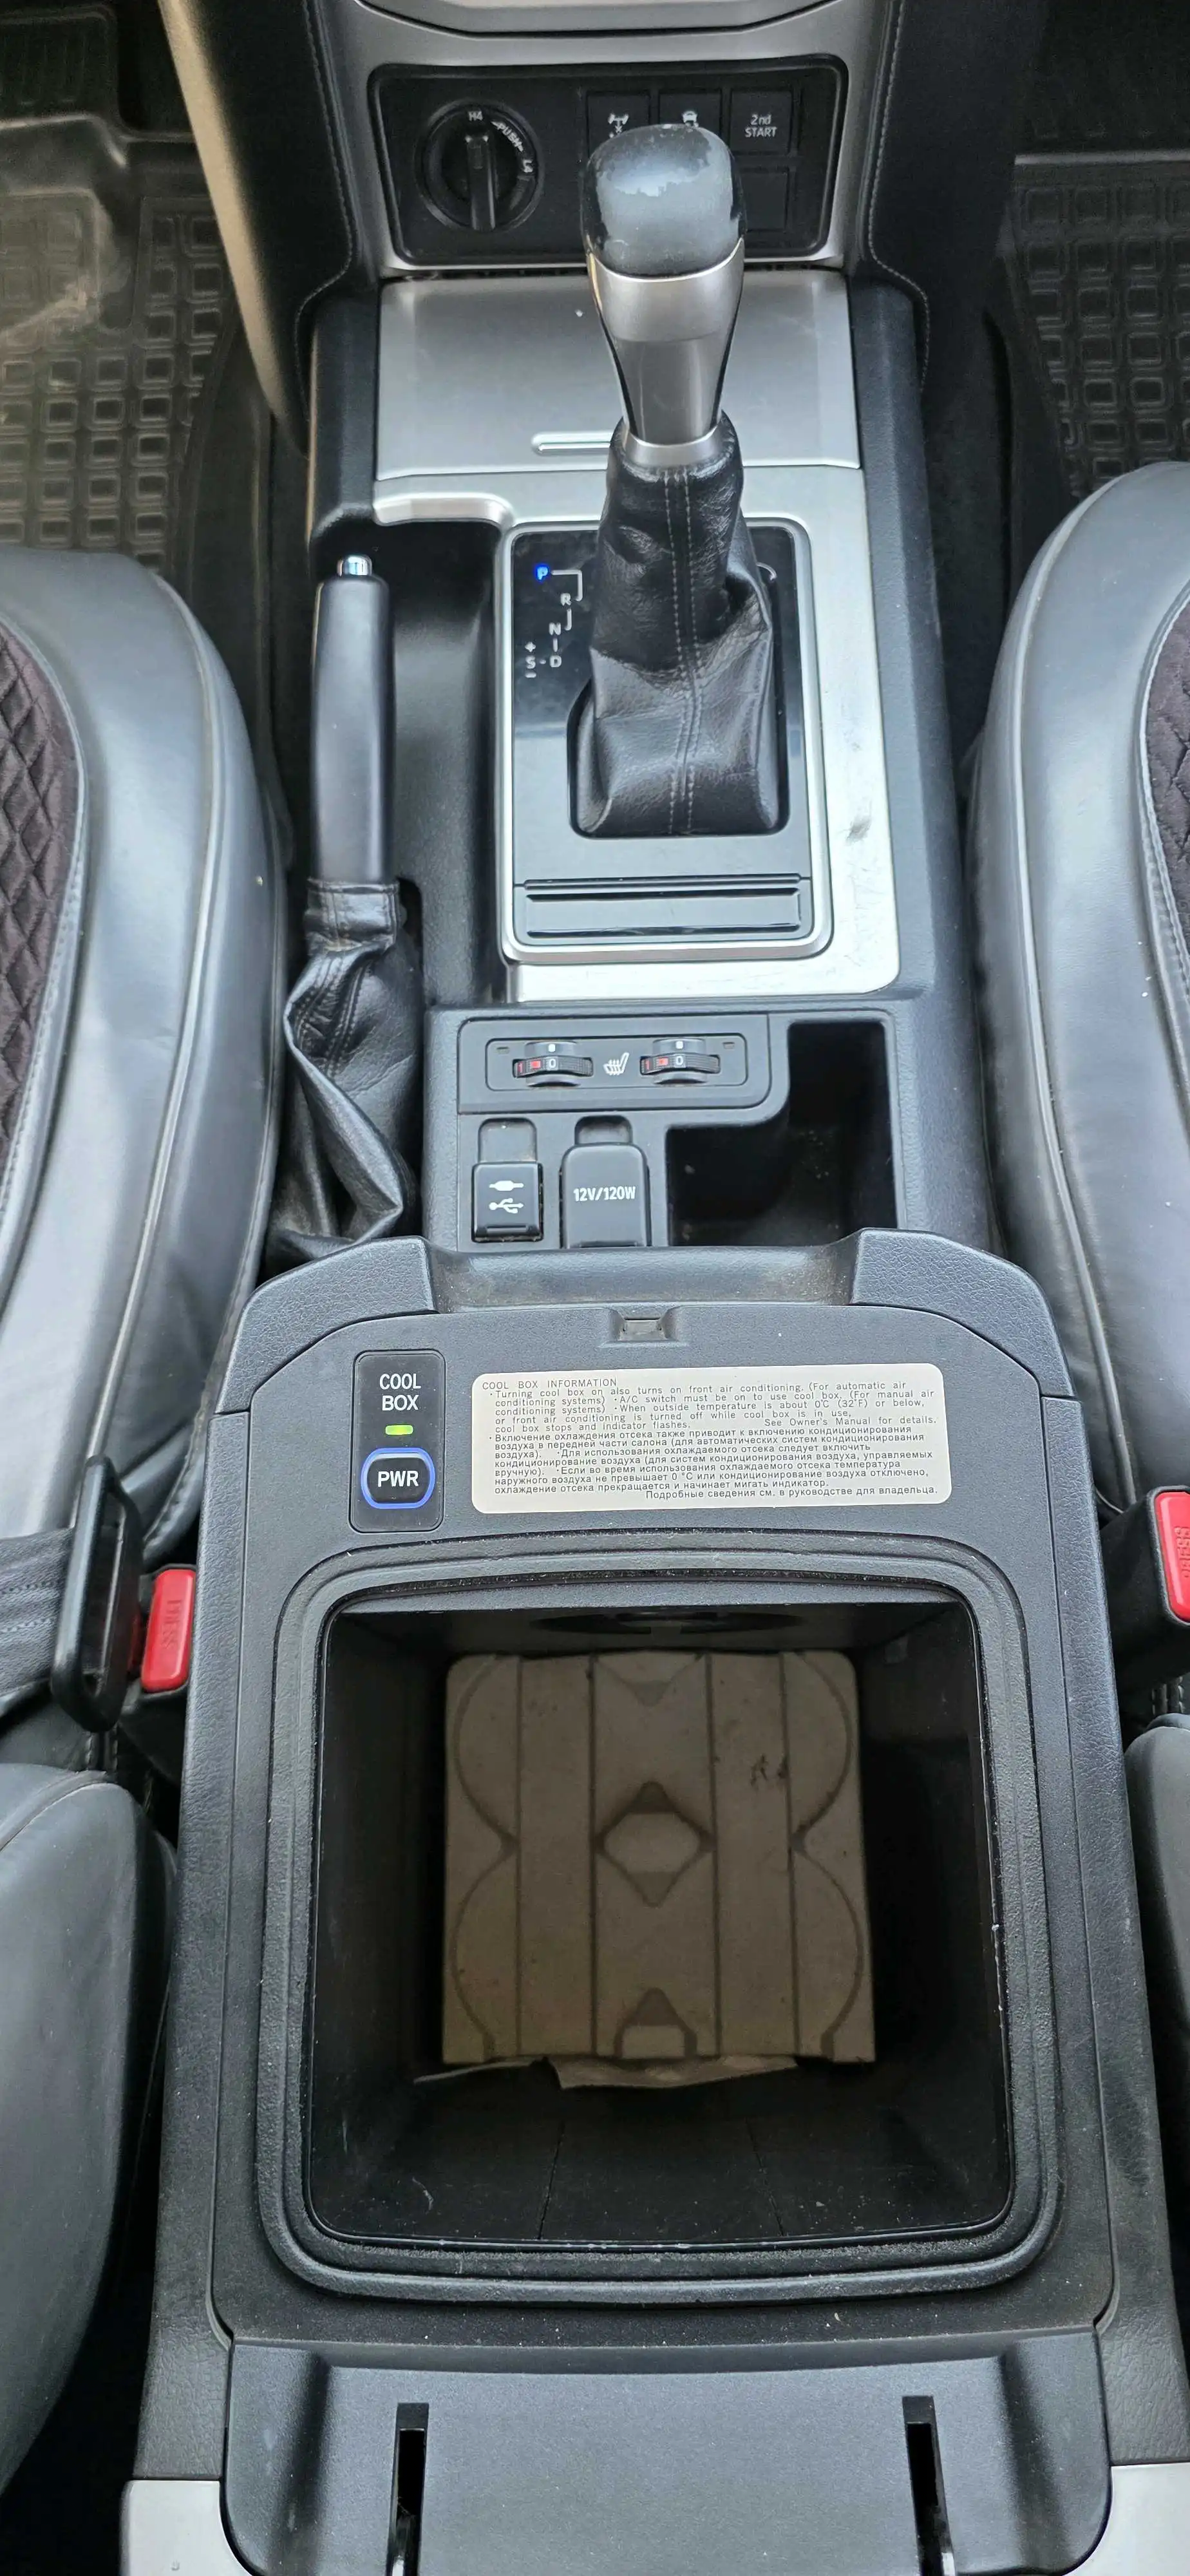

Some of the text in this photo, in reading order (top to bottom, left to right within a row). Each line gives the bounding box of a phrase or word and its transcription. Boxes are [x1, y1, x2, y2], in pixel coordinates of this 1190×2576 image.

[468, 110, 483, 121] H4
[751, 114, 771, 125] 2nd
[745, 126, 777, 137] START
[537, 567, 548, 580] P
[560, 592, 571, 606] R
[549, 622, 562, 636] N
[525, 655, 536, 669] S
[549, 654, 562, 668] D
[549, 1058, 556, 1069] 0
[675, 1056, 683, 1065] 0
[573, 1186, 636, 1202] 12V/120W
[379, 1373, 422, 1390] COOL
[482, 1378, 616, 1390] COOL BOX INFORMATION
[540, 1388, 560, 1397] cool
[567, 1387, 584, 1396] box
[610, 1386, 630, 1395] also
[638, 1385, 663, 1394] turns
[689, 1384, 712, 1393] front
[720, 1383, 733, 1392] air
[809, 1382, 829, 1392] (For
[836, 1381, 885, 1390] automatic
[892, 1381, 906, 1389] air
[382, 1394, 419, 1411] BOX
[496, 1397, 556, 1408] conditioning
[562, 1396, 605, 1406] systems)
[645, 1394, 676, 1403] switch
[684, 1393, 708, 1402] must
[715, 1392, 727, 1401] be
[753, 1392, 762, 1400] to
[794, 1391, 814, 1399] cool
[849, 1390, 870, 1401] (For
[878, 1389, 913, 1398] manual
[921, 1389, 934, 1397] air
[496, 1405, 556, 1417] conditioning
[562, 1404, 605, 1416] systems)
[653, 1402, 689, 1411] outside
[696, 1401, 757, 1412] temperature
[764, 1400, 772, 1409] is
[780, 1399, 808, 1408] about
[513, 1415, 536, 1424] front
[543, 1414, 557, 1423] air
[565, 1412, 625, 1424] conditioning
[634, 1412, 642, 1421] is
[650, 1411, 681, 1420] turned
[690, 1410, 703, 1419] off
[710, 1410, 736, 1419] while
[744, 1409, 764, 1418] cool
[772, 1409, 789, 1417] box
[798, 1408, 806, 1417] is
[814, 1408, 823, 1417] in
[764, 1415, 936, 1426] See Owner's Manual for details.
[496, 1419, 690, 1434] cool box stops and indicator flashes.
[554, 1432, 616, 1441] охлаждения
[689, 1429, 736, 1439] приводит
[809, 1426, 911, 1436] кондиционирования
[495, 1442, 534, 1452] воздуха
[547, 1439, 596, 1450] передней
[671, 1437, 693, 1447] (для
[697, 1436, 778, 1444] автоматических
[821, 1434, 924, 1444] кондиционирования
[495, 1449, 542, 1461] воздуха).
[584, 1447, 661, 1456] использования
[664, 1446, 737, 1455] охлаждаемого
[778, 1444, 818, 1454] следует
[495, 1458, 597, 1469] кондиционирование
[601, 1457, 641, 1466] воздуха
[645, 1454, 666, 1465] (для
[710, 1453, 812, 1464] кондиционирования
[816, 1452, 860, 1462] воздуха,
[863, 1451, 932, 1461] управляемых
[495, 1466, 544, 1478] вручную).
[605, 1466, 636, 1475] время
[639, 1464, 716, 1472] использования
[719, 1463, 793, 1472] охлаждаемого
[834, 1461, 900, 1470] температура
[495, 1477, 548, 1486] наружного
[552, 1475, 591, 1485] воздуха
[611, 1473, 668, 1483] превышает
[672, 1472, 677, 1480] 0
[719, 1470, 822, 1481] кондиционирование
[826, 1470, 866, 1479] воздуха
[870, 1468, 928, 1478] отключено,
[377, 1470, 419, 1488] PWR
[495, 1485, 556, 1495] охлаждение
[598, 1482, 670, 1493] прекращается
[772, 1479, 829, 1489] индикатор.
[646, 1489, 704, 1501] Подробные
[708, 1489, 755, 1499] сведения
[789, 1488, 853, 1497] руководстве
[856, 1487, 875, 1495] для
[879, 1486, 937, 1495] владельца.
